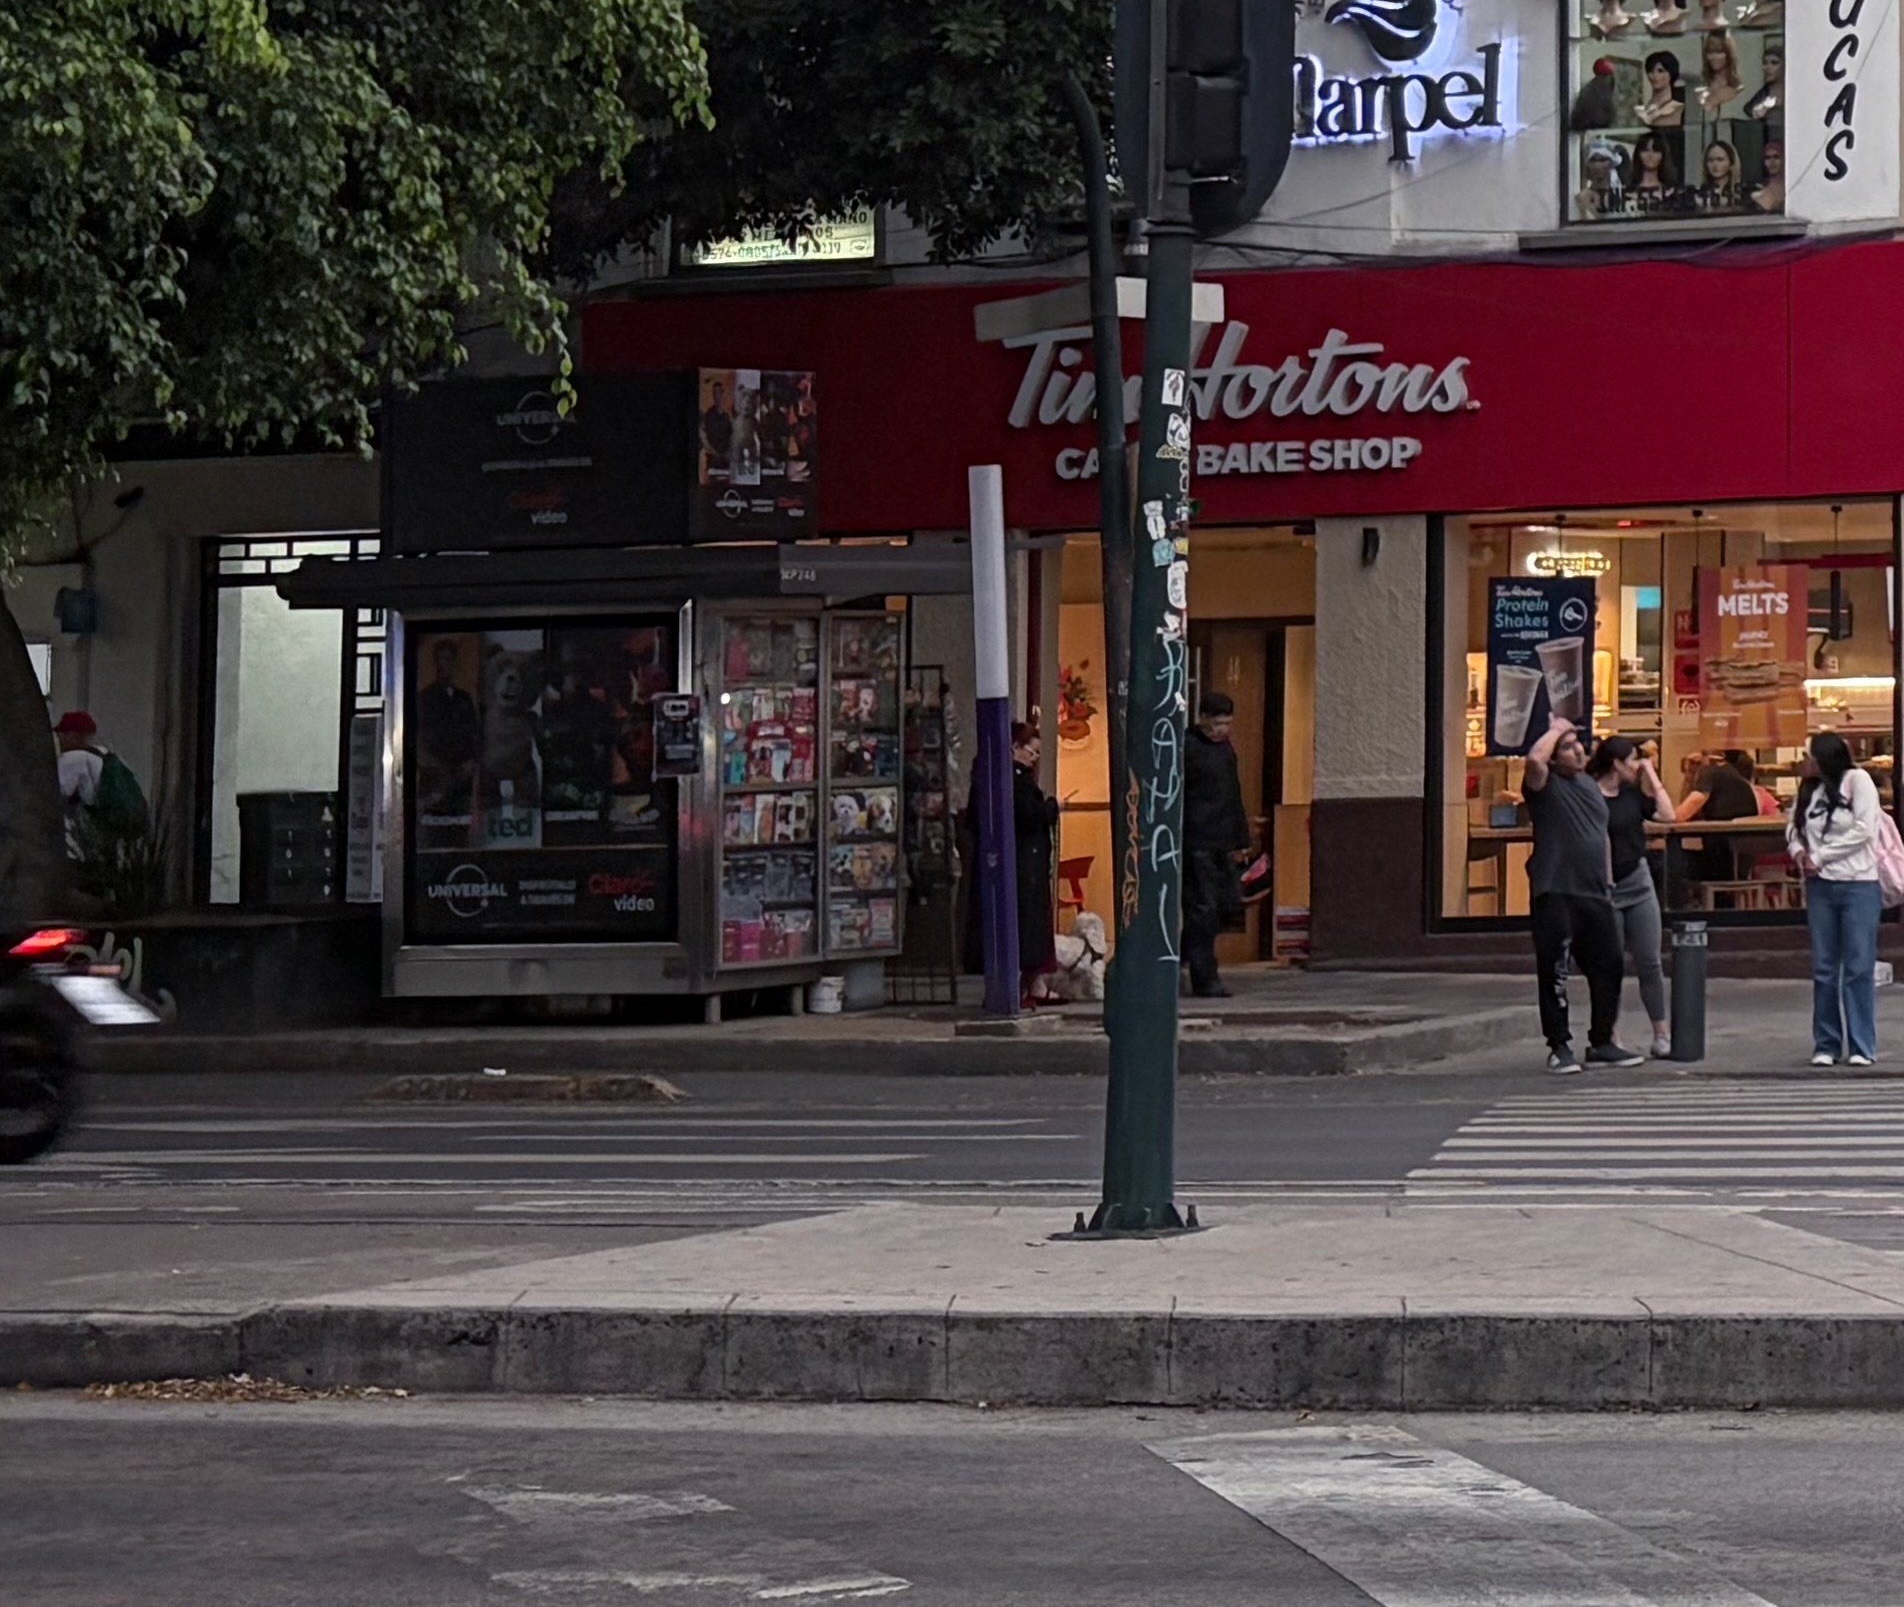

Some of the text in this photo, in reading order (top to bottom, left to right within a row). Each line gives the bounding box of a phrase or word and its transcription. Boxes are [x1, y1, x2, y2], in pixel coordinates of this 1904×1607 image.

[1055, 437, 1421, 480] CA BAKE SHOP
[1496, 598, 1549, 612] Protein
[1718, 592, 1789, 616] MELTS
[1495, 613, 1549, 629] Shakes
[488, 814, 533, 838] ted
[428, 882, 509, 899] UNIVERSAL
[613, 896, 656, 912] video
